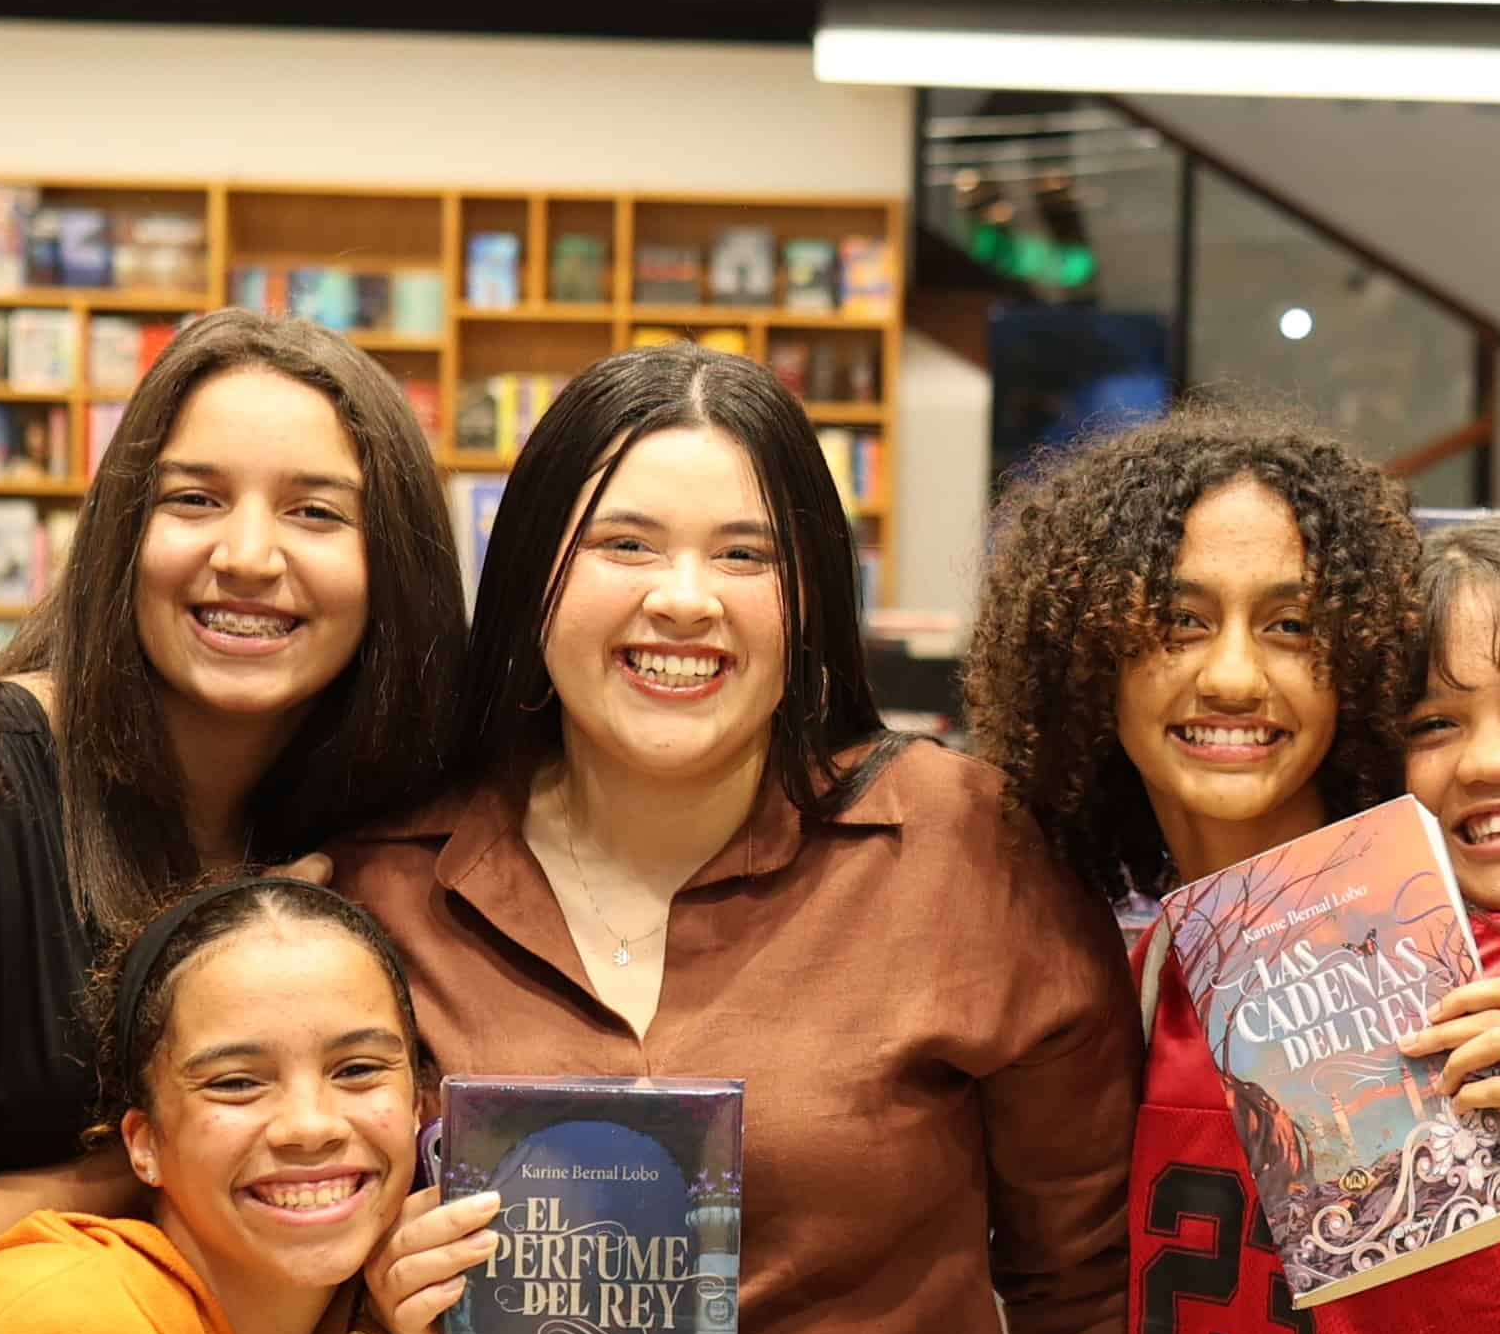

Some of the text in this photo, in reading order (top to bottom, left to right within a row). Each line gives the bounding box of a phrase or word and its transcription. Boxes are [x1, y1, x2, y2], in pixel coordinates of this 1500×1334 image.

[1242, 883, 1368, 945] Karine Bernal Lobo
[1253, 939, 1321, 991] LAS
[1235, 937, 1428, 1043] CADENAS
[1282, 982, 1435, 1073] DEL REY
[521, 1164, 659, 1181] Karine Bernal Lobo
[526, 1197, 570, 1232] EL
[485, 1234, 690, 1281] PERFUME
[522, 1282, 685, 1329] DEL REY
